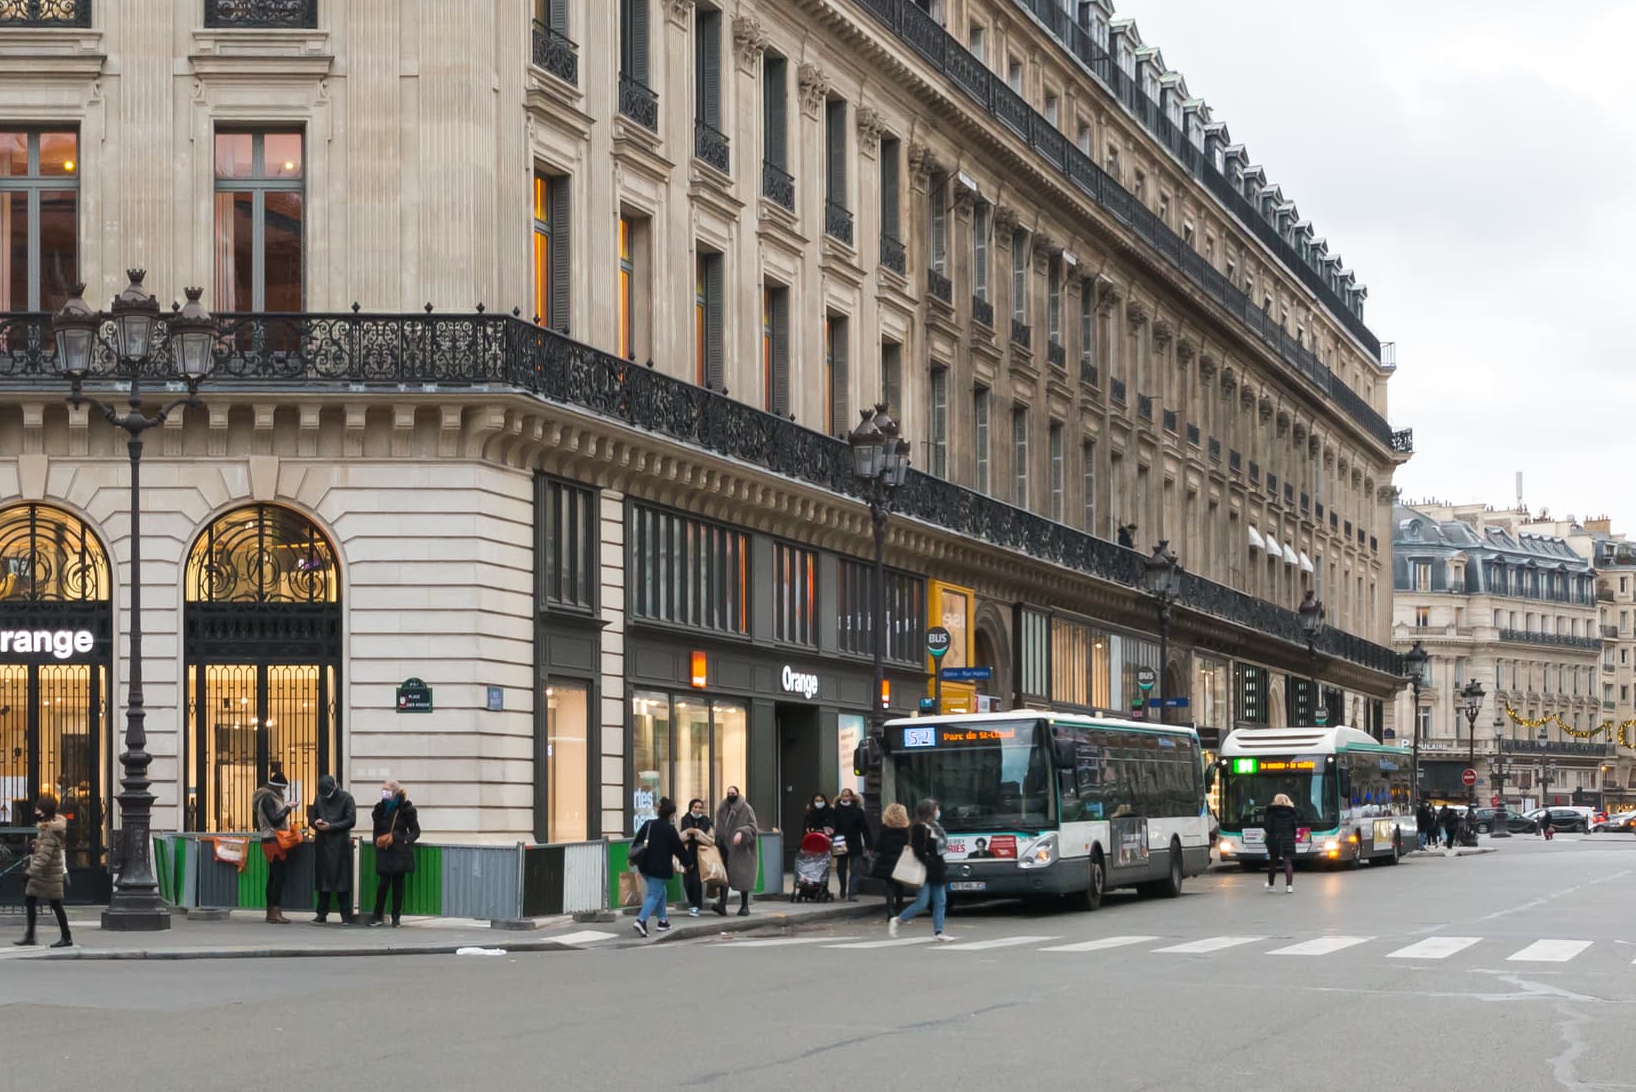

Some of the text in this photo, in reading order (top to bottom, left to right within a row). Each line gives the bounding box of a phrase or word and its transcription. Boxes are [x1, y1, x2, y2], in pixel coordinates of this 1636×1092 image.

[928, 633, 947, 643] BUS
[782, 665, 818, 699] Orange
[1138, 672, 1153, 680] BUS
[909, 730, 931, 745] 52
[944, 732, 964, 741] Parc
[966, 731, 977, 740] de
